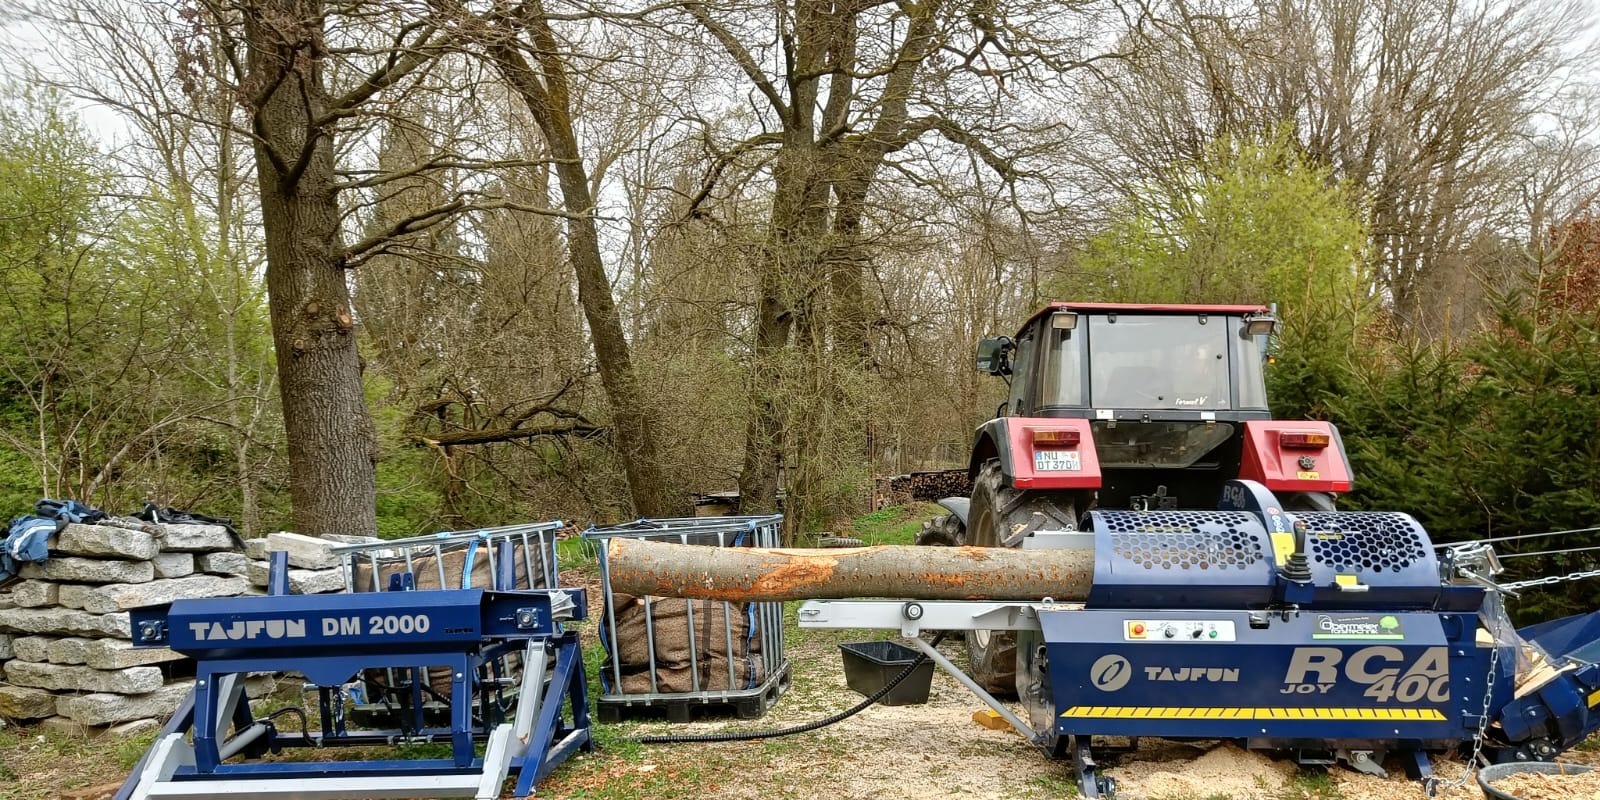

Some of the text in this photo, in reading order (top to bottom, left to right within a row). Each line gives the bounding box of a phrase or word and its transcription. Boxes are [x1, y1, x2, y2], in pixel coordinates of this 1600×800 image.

[1044, 452, 1058, 460] NU
[1037, 460, 1050, 470] DT
[1223, 485, 1245, 502] RCA
[189, 614, 430, 640] TAJFUN DM 2000
[1284, 645, 1449, 684] RCA
[1144, 666, 1240, 682] TAJFUN
[1279, 684, 1335, 694] JOY
